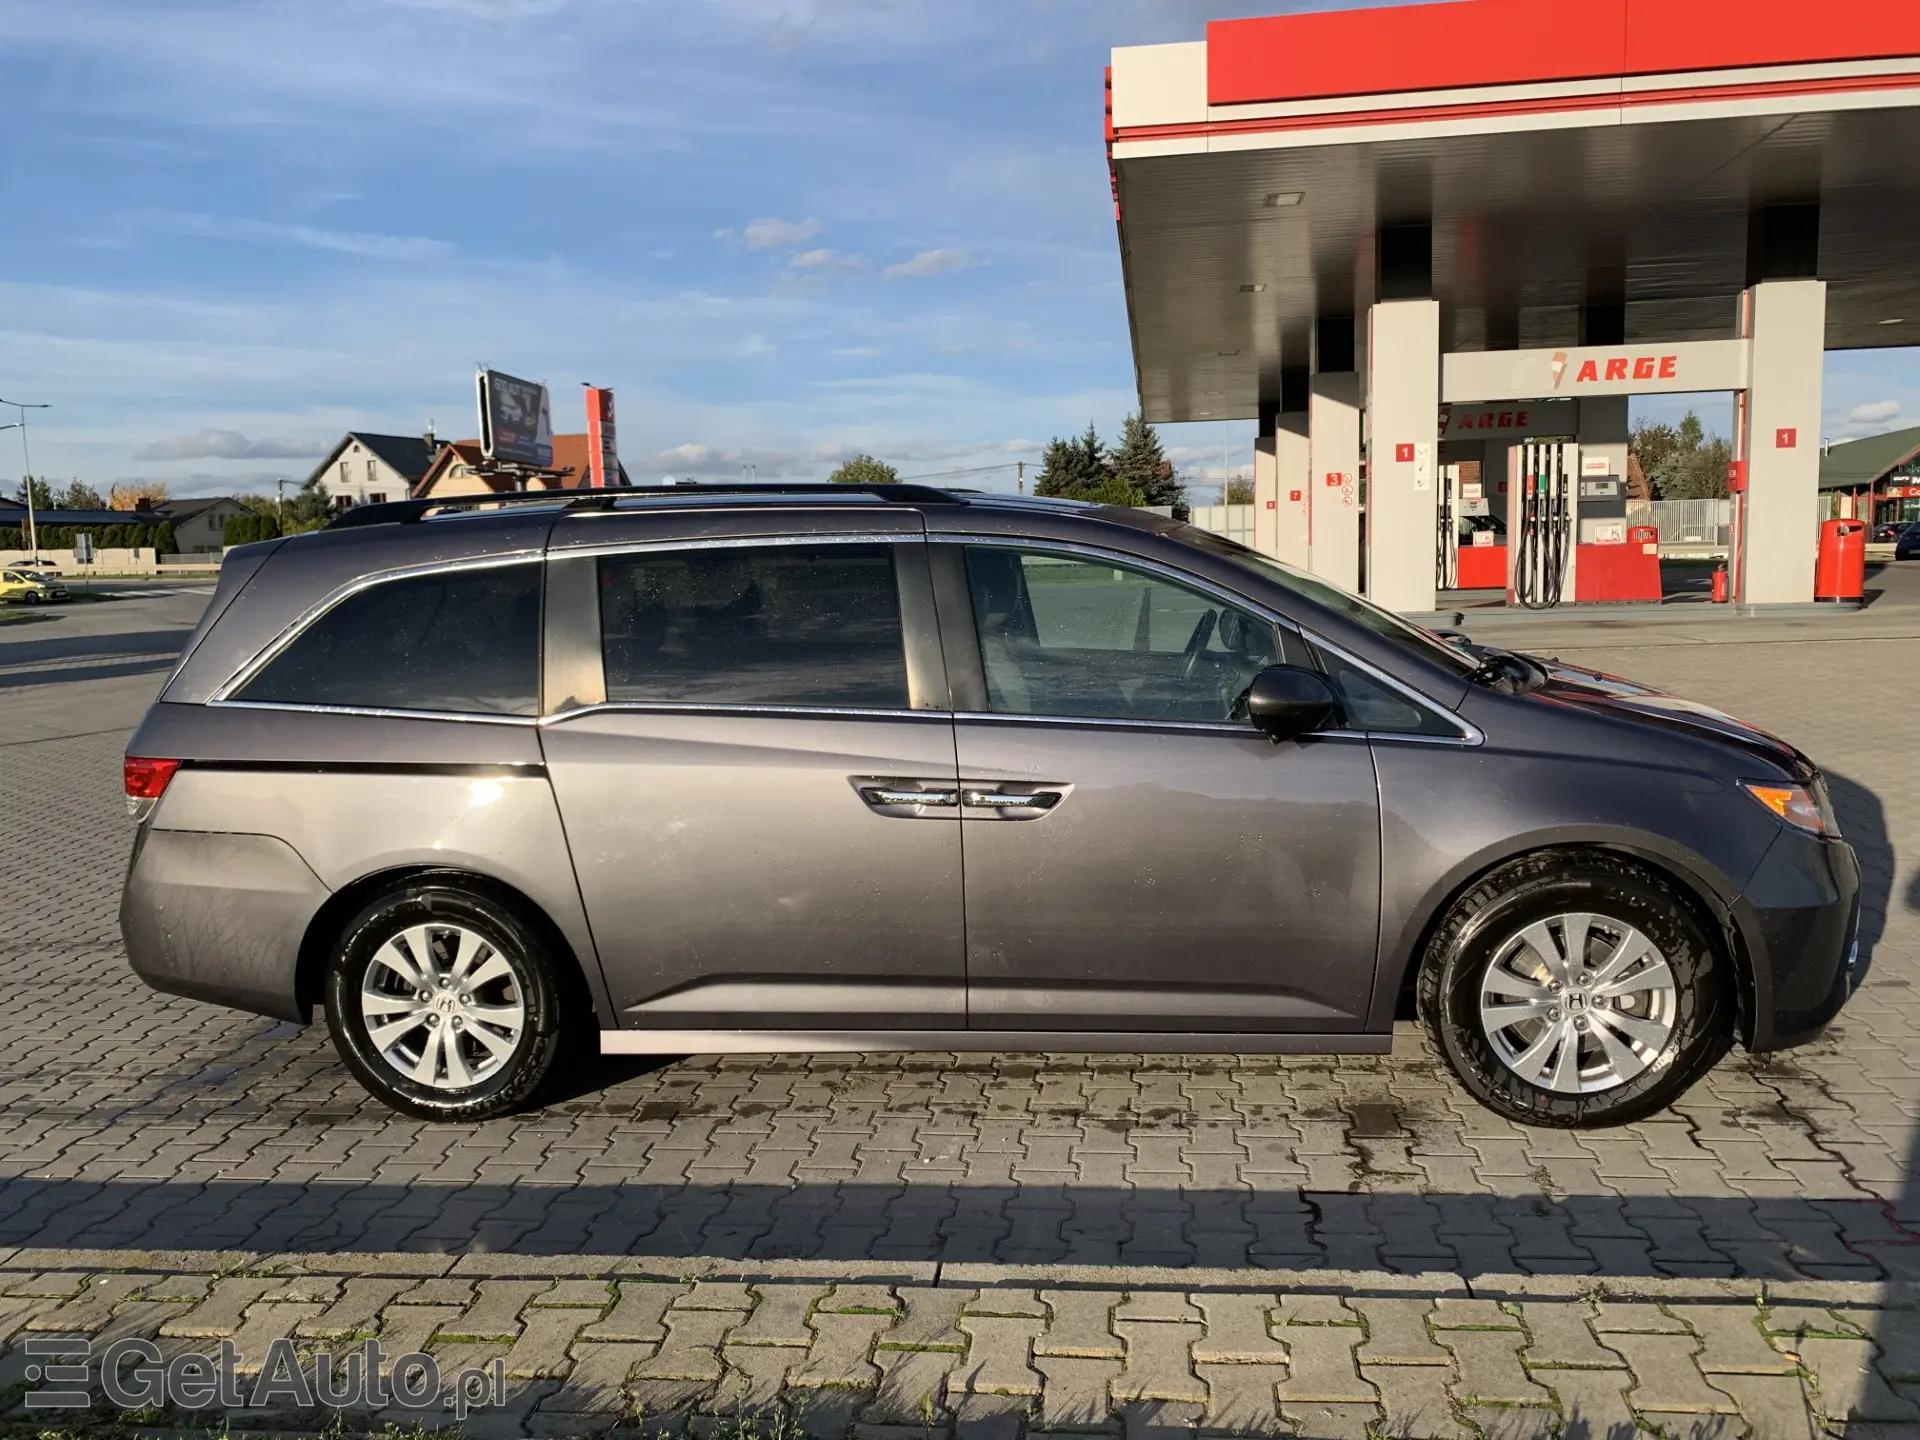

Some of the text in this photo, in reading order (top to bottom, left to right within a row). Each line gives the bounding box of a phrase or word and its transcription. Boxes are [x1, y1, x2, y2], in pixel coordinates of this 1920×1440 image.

[1576, 356, 1677, 382] ARGE
[1458, 411, 1529, 430] ARGE
[1330, 474, 1339, 486] 3
